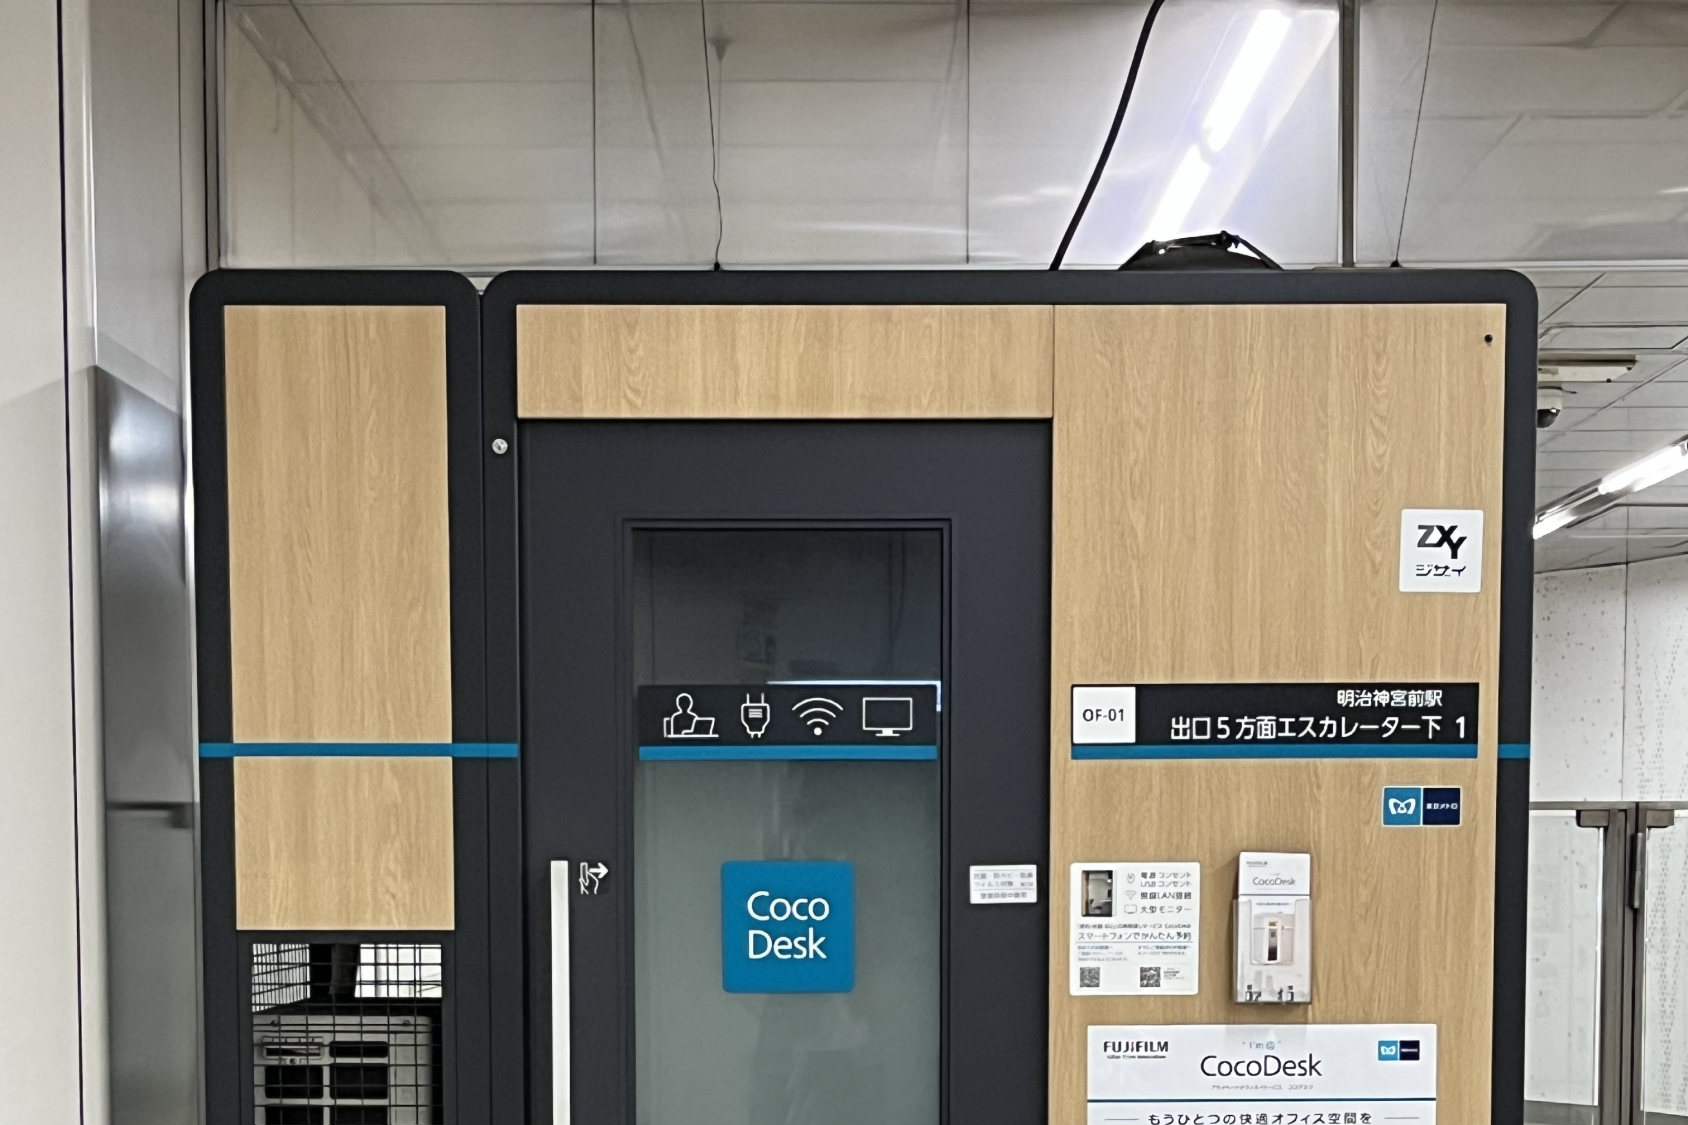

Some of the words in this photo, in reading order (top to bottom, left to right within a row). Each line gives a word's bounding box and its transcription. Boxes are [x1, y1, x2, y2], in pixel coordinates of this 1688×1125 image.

[1417, 525, 1467, 559] ZXY
[1337, 690, 1442, 707] 明治神宮前駅
[1082, 708, 1125, 722] OF-01
[1455, 715, 1465, 739] 1
[746, 890, 830, 921] Coco
[748, 926, 827, 959] Desk
[1103, 1041, 1169, 1053] FUJIFILM
[1200, 1053, 1323, 1077] CocoDesk
[1148, 1112, 1372, 1125] もうひとつの快適オフィス空間を
